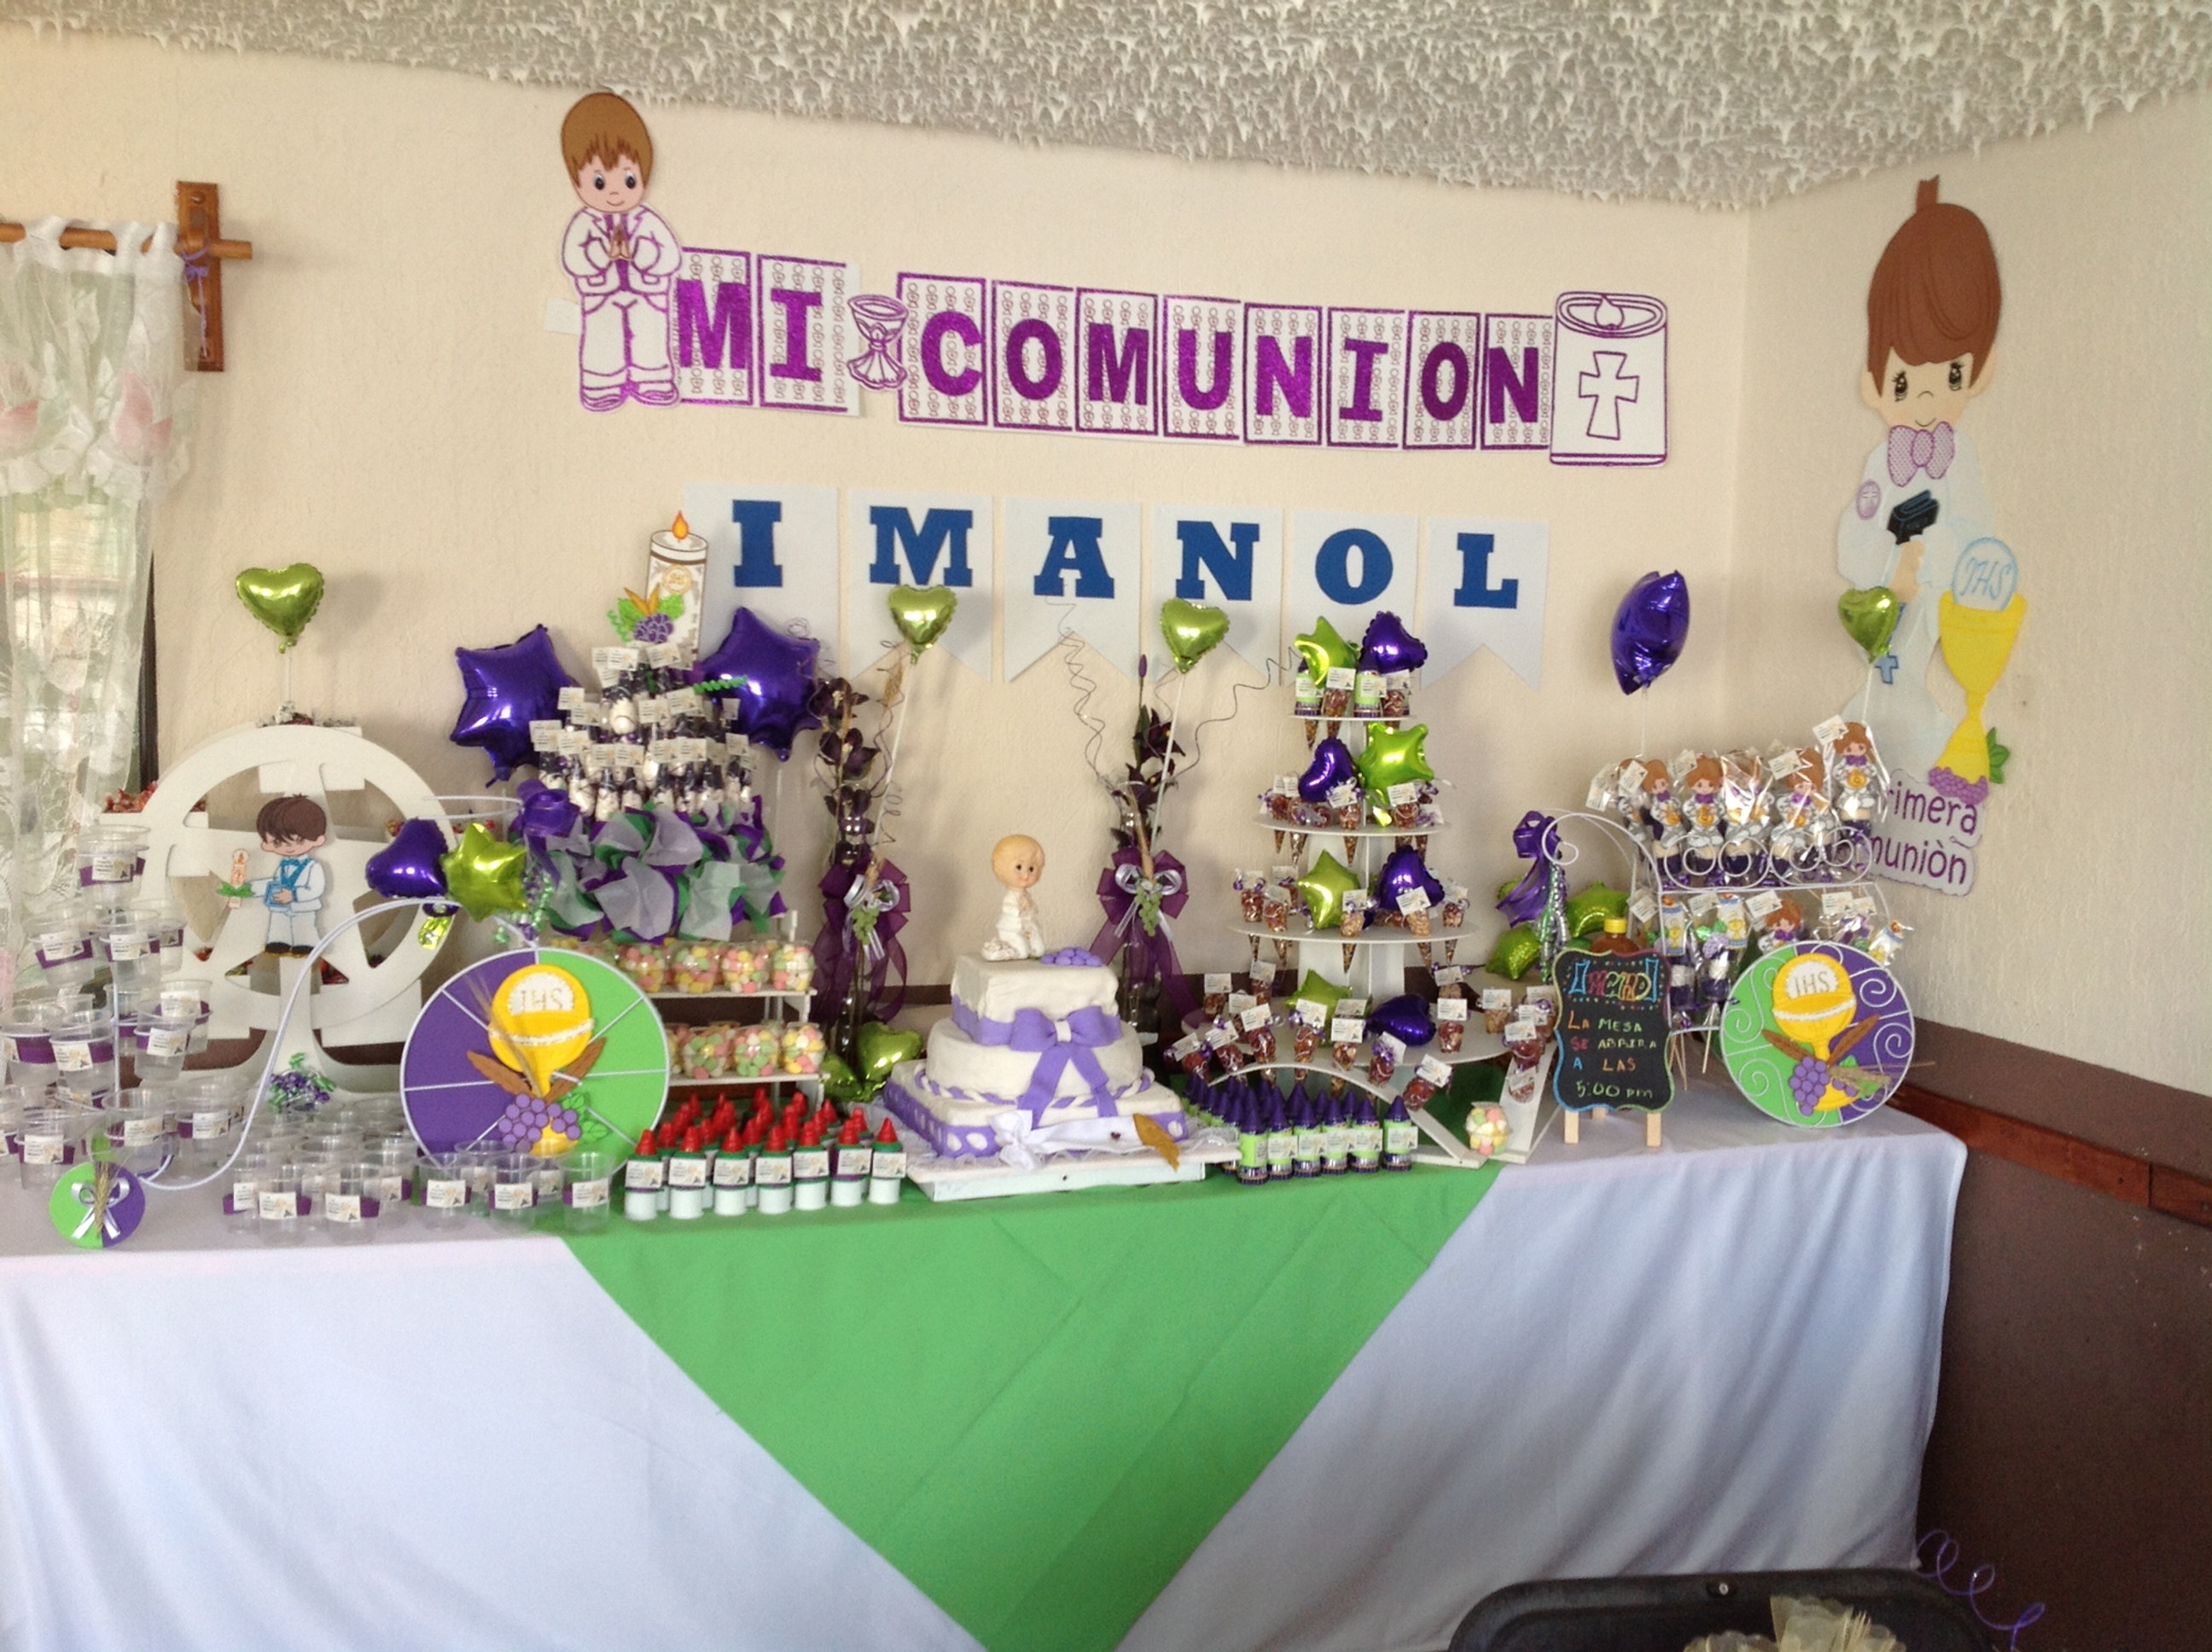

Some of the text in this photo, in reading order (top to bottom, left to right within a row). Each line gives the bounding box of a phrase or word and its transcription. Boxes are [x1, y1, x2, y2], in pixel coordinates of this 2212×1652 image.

[677, 278, 1540, 425] MI COMUNION
[732, 499, 1519, 609] IMANOL
[1598, 1017, 1643, 1032] MESA
[1570, 1036, 1590, 1051] SE
[1573, 1056, 1637, 1072] A LAS
[1575, 1079, 1621, 1098] 5:00
